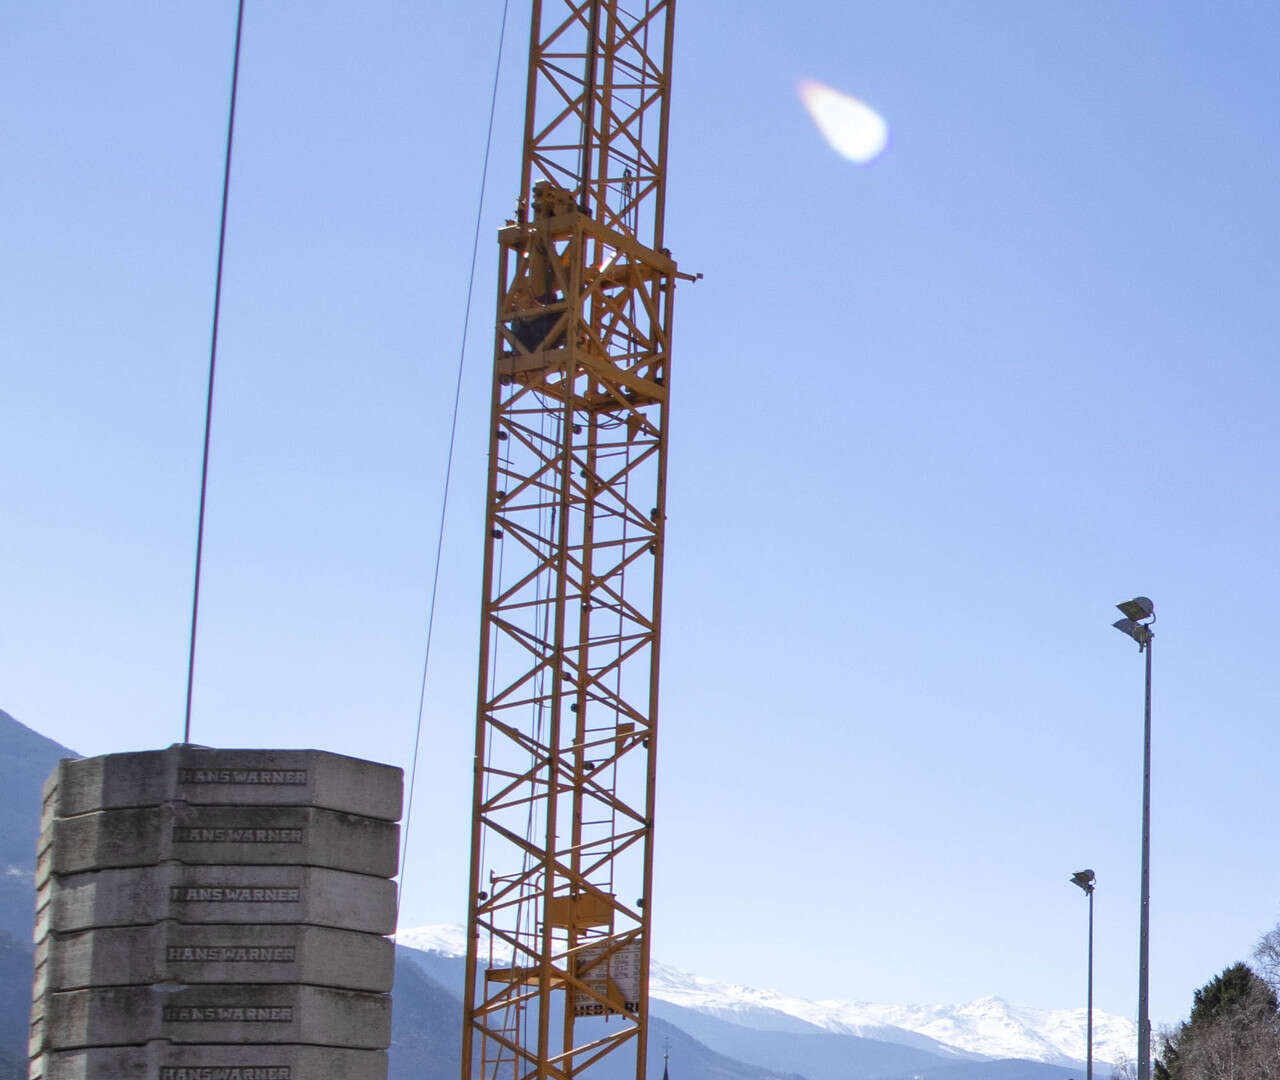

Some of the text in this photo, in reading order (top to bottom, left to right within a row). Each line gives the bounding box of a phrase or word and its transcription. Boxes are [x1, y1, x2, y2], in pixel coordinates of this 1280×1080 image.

[233, 771, 307, 784] WARNER
[228, 829, 303, 842] WARNER
[225, 889, 300, 901] WARNER
[168, 948, 295, 961] HANS WARNER
[218, 1008, 293, 1020] WARNER
[162, 1068, 291, 1080] HANS WARNER
